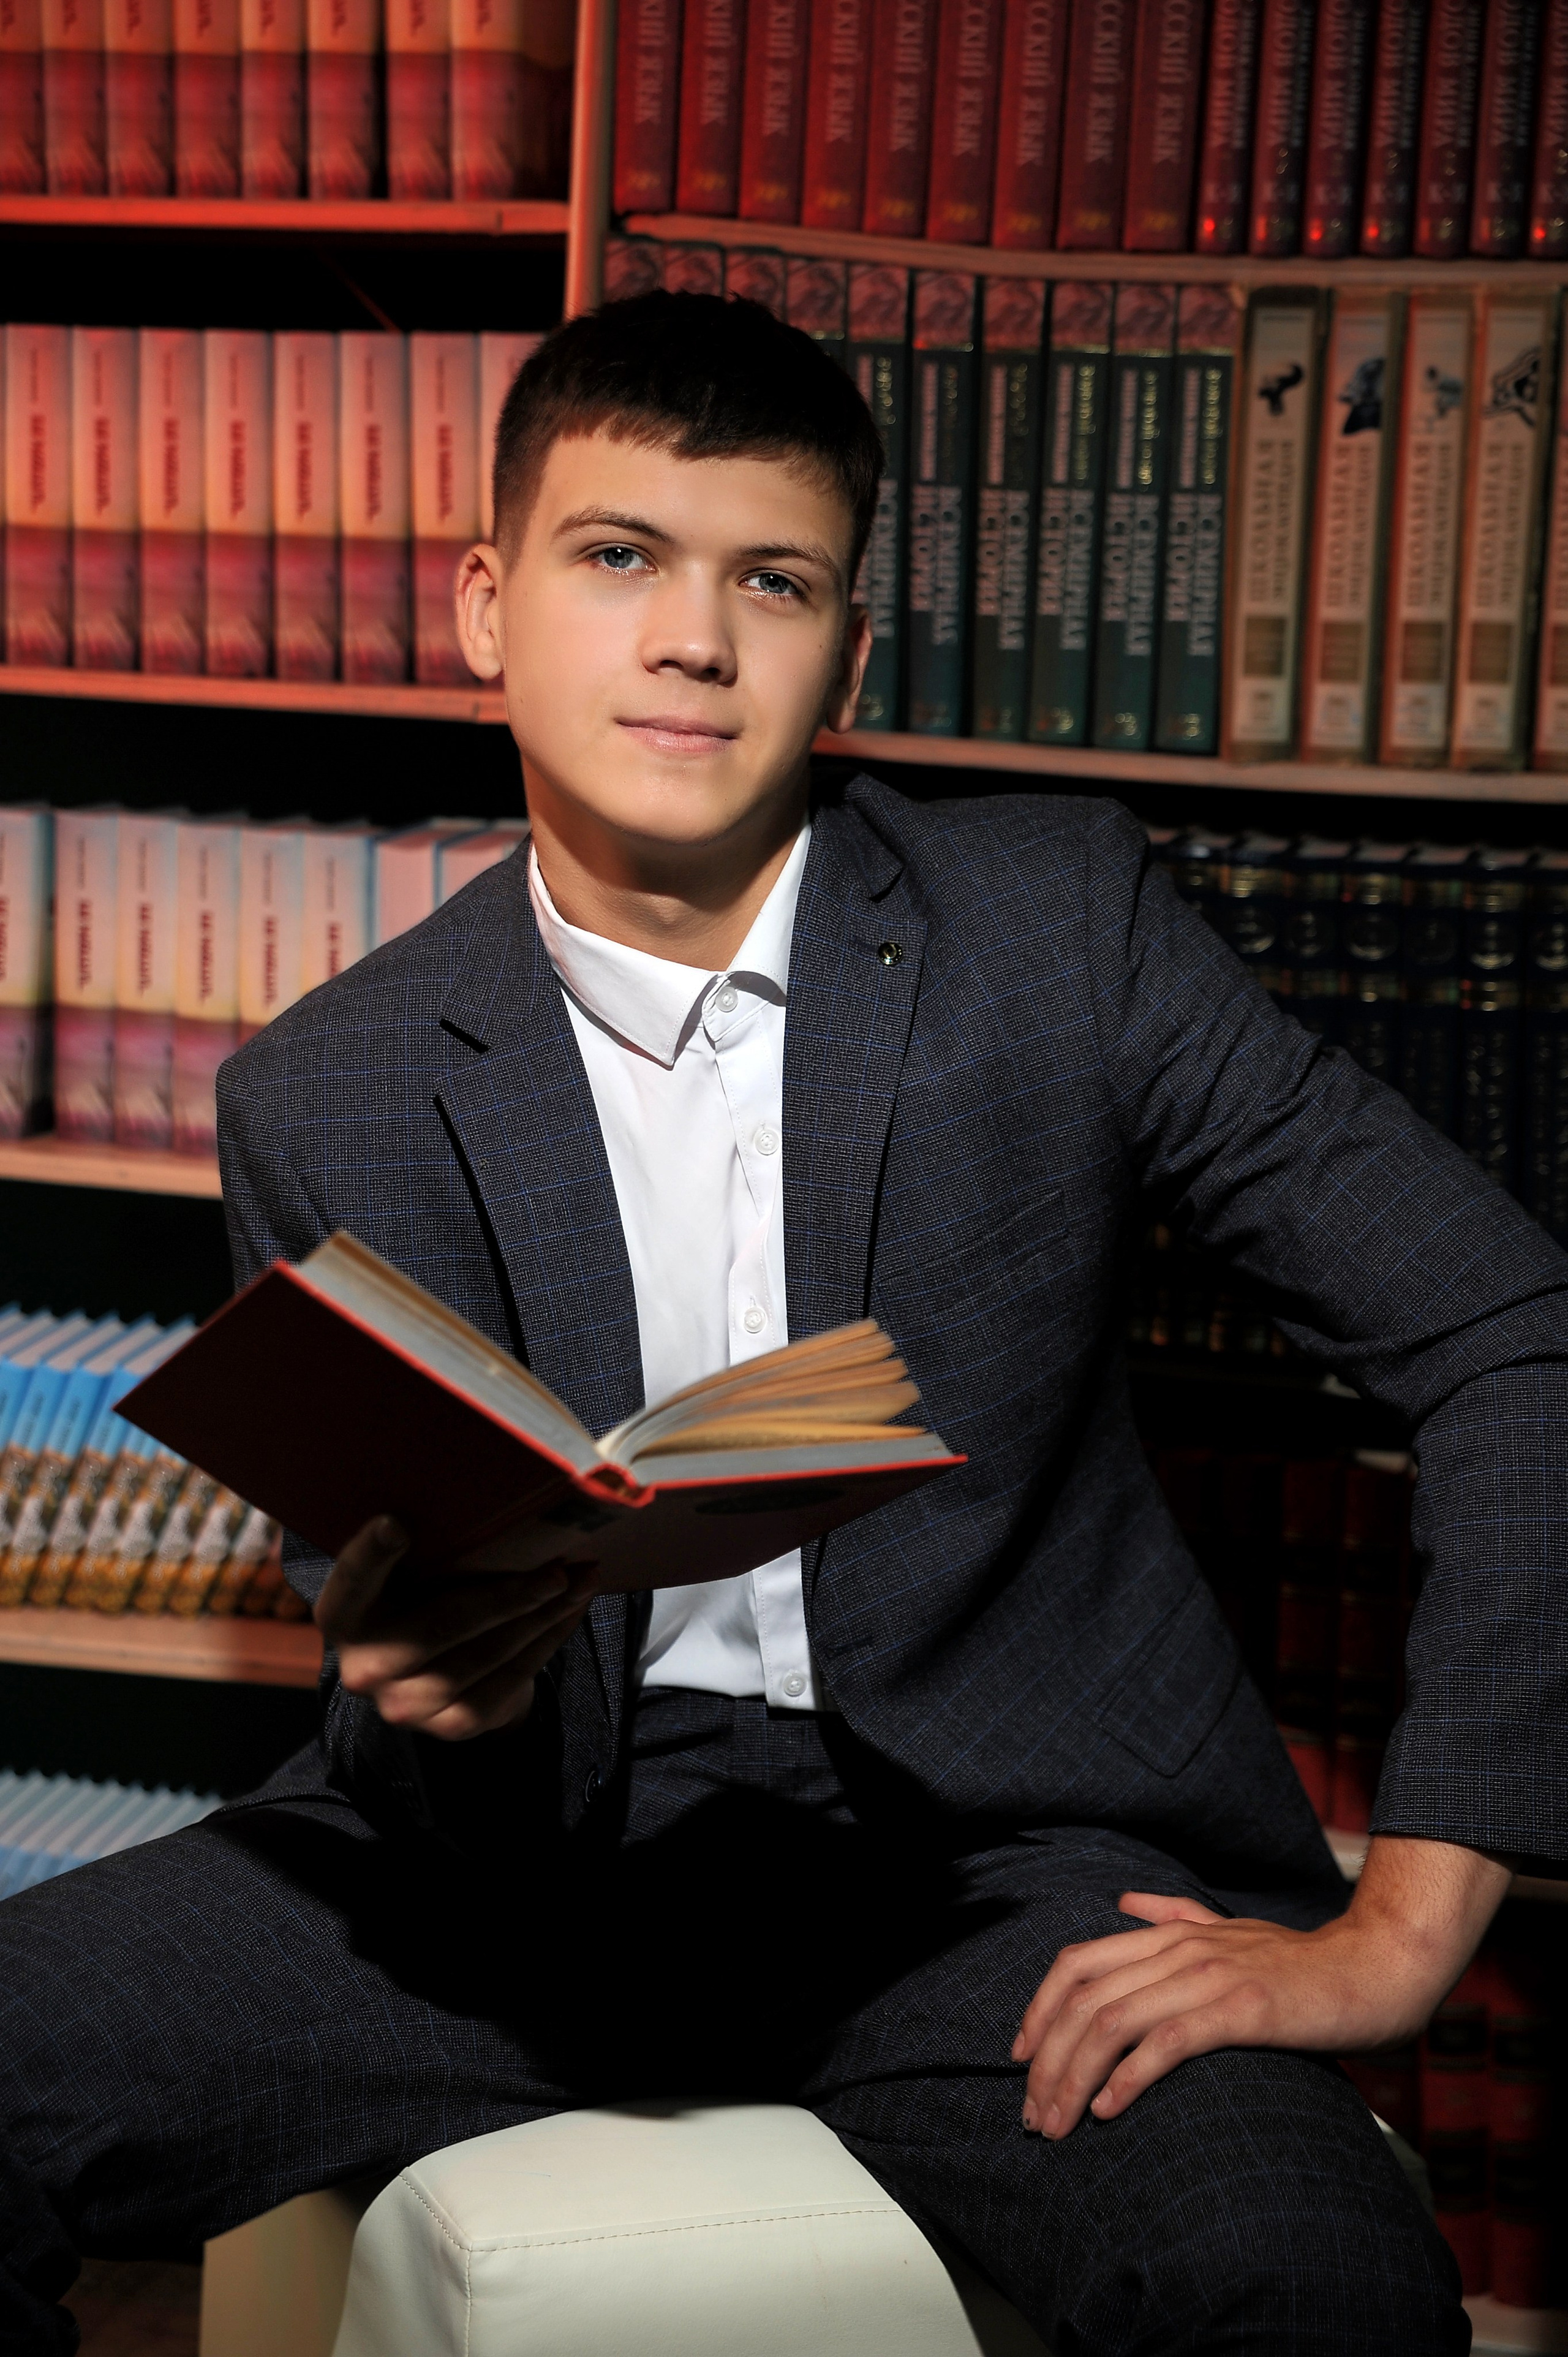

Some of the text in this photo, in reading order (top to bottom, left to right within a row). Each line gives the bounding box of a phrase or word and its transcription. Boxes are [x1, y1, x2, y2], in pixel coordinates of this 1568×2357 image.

[635, 56, 665, 125] ЯЗЫК
[699, 56, 731, 126] ЯЗЫК
[761, 0, 799, 137] КИЙ ЯЗЫК
[825, 74, 856, 143] ЯЗЫК
[889, 0, 928, 152] СКИЙ ЯЗЫК
[951, 85, 982, 157] ЯЗЫК
[1015, 93, 1047, 167] ЯЗЫК
[1084, 92, 1116, 165] ЯЗЫК
[1151, 93, 1185, 165] ЯЗЫК
[910, 483, 938, 612] ИСТОРИЯ
[932, 485, 962, 646] ВСЕМИРНАЯ
[976, 486, 1005, 616] ИСТОРИЯ
[998, 491, 1030, 650] ВСЕМИРНАЯ
[1038, 488, 1069, 615] ИСТОРИЯ
[1059, 488, 1094, 651] ВСЕМИРНАЯ
[1101, 492, 1134, 622] ИСТОРИЯ
[1126, 493, 1159, 656] ВСЕМИРНАЯ
[1165, 492, 1197, 622] ИСТОРИЯ
[1186, 493, 1222, 657] ВСЕМИРНАЯ
